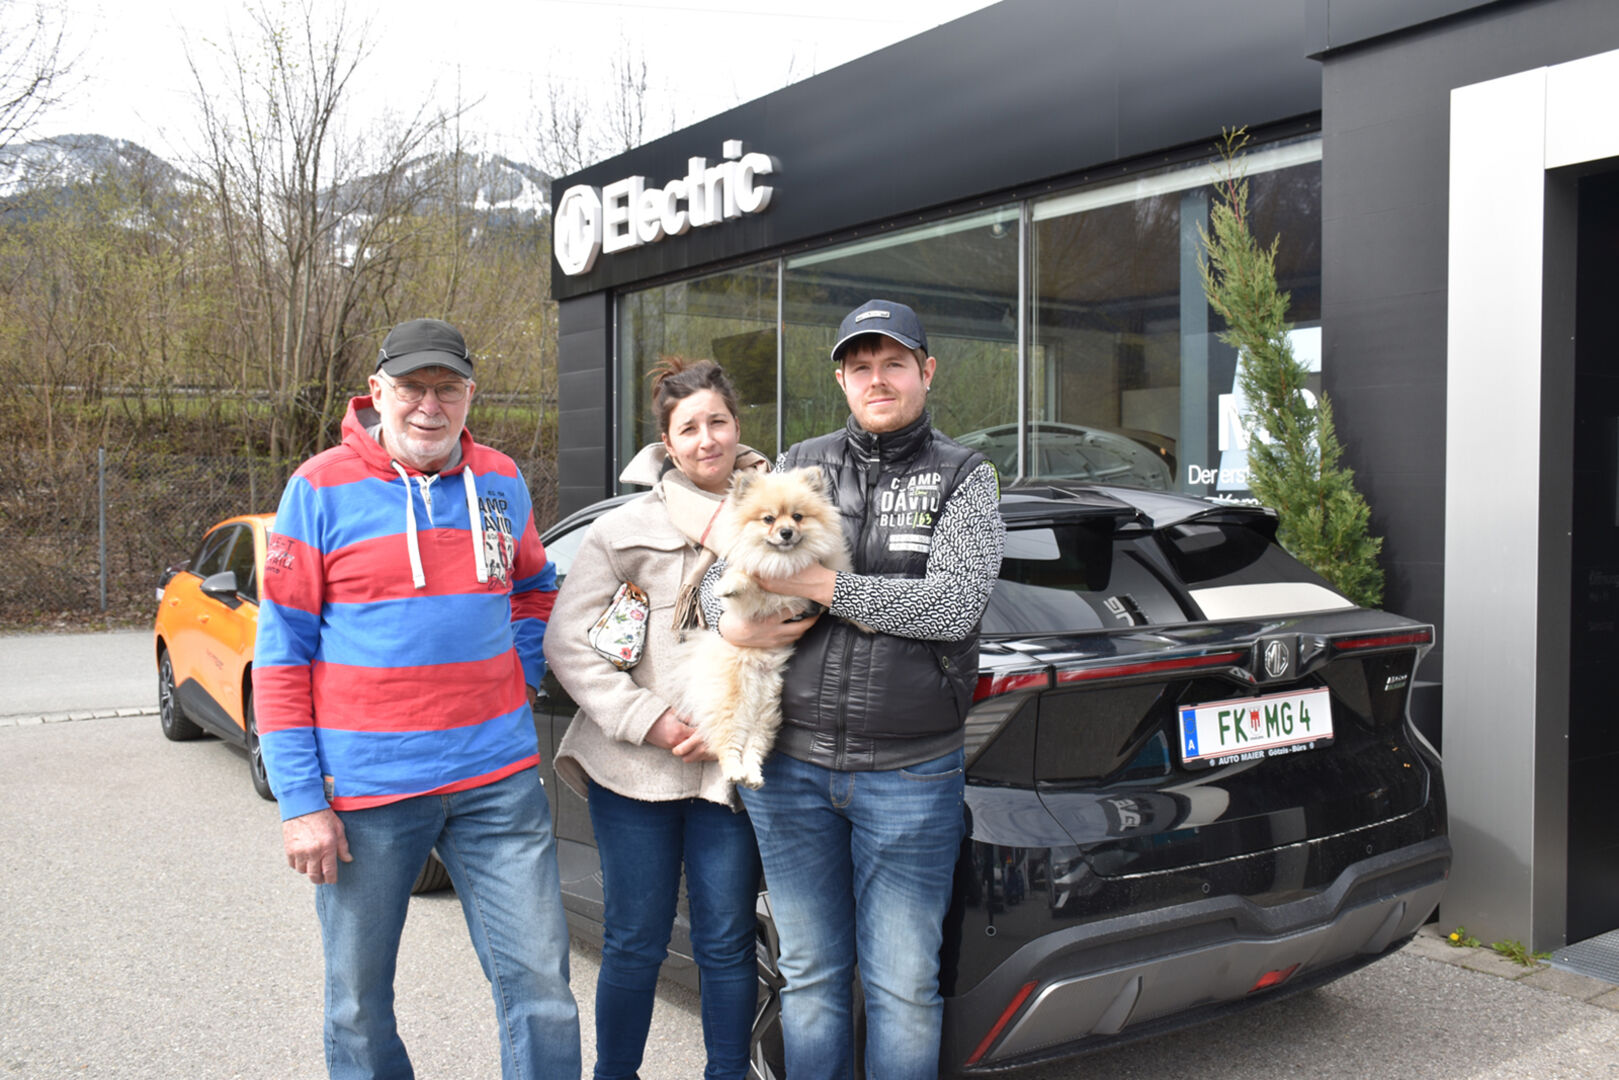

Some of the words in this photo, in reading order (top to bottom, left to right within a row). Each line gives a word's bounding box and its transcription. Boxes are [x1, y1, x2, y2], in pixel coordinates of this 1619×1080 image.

[602, 139, 774, 254] Electric
[1188, 464, 1219, 485] Der
[1217, 708, 1248, 746] FK
[1264, 702, 1293, 738] MG
[1299, 700, 1311, 732] 4
[1187, 739, 1196, 751] A
[1218, 754, 1240, 766] AUTO
[1241, 750, 1265, 761] MAIER
